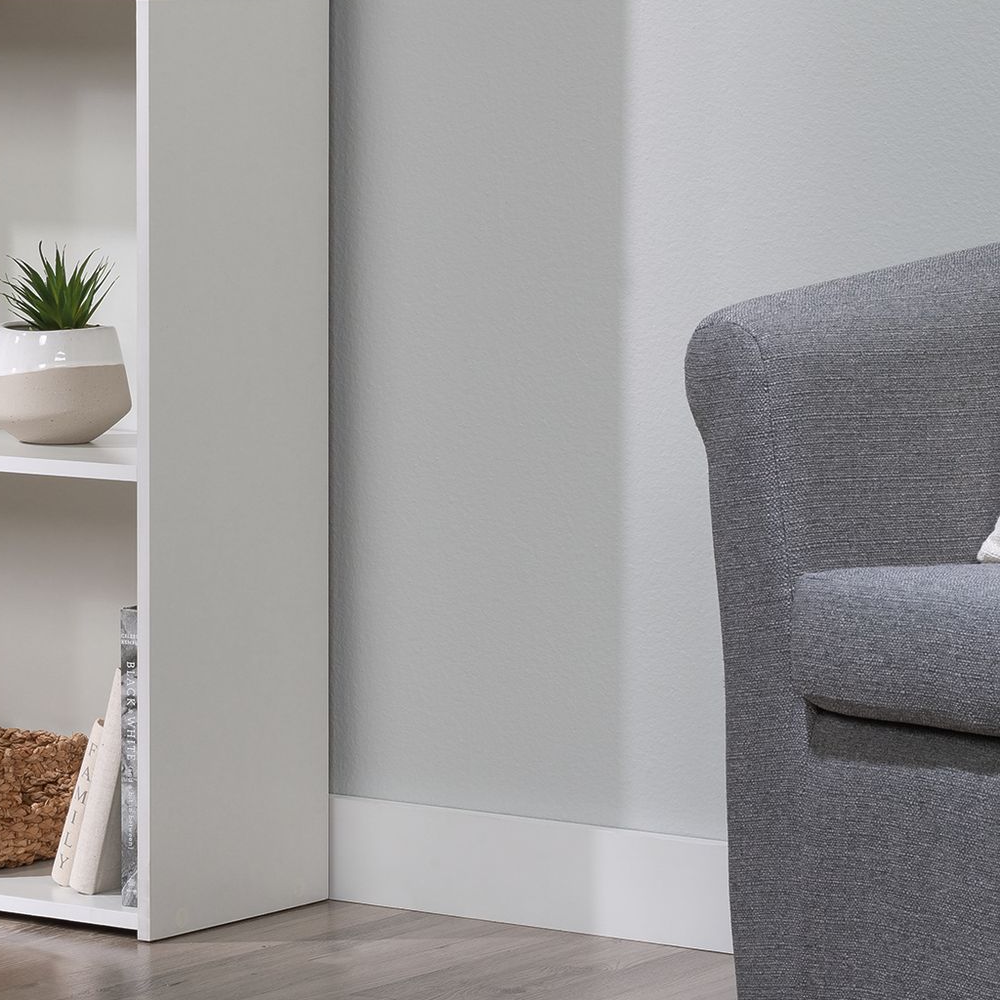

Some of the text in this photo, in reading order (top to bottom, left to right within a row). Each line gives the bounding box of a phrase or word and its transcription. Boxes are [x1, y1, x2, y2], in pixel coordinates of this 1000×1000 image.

[126, 661, 136, 707] BLACK
[126, 716, 136, 761] WHITE
[58, 741, 98, 871] FAMILY
